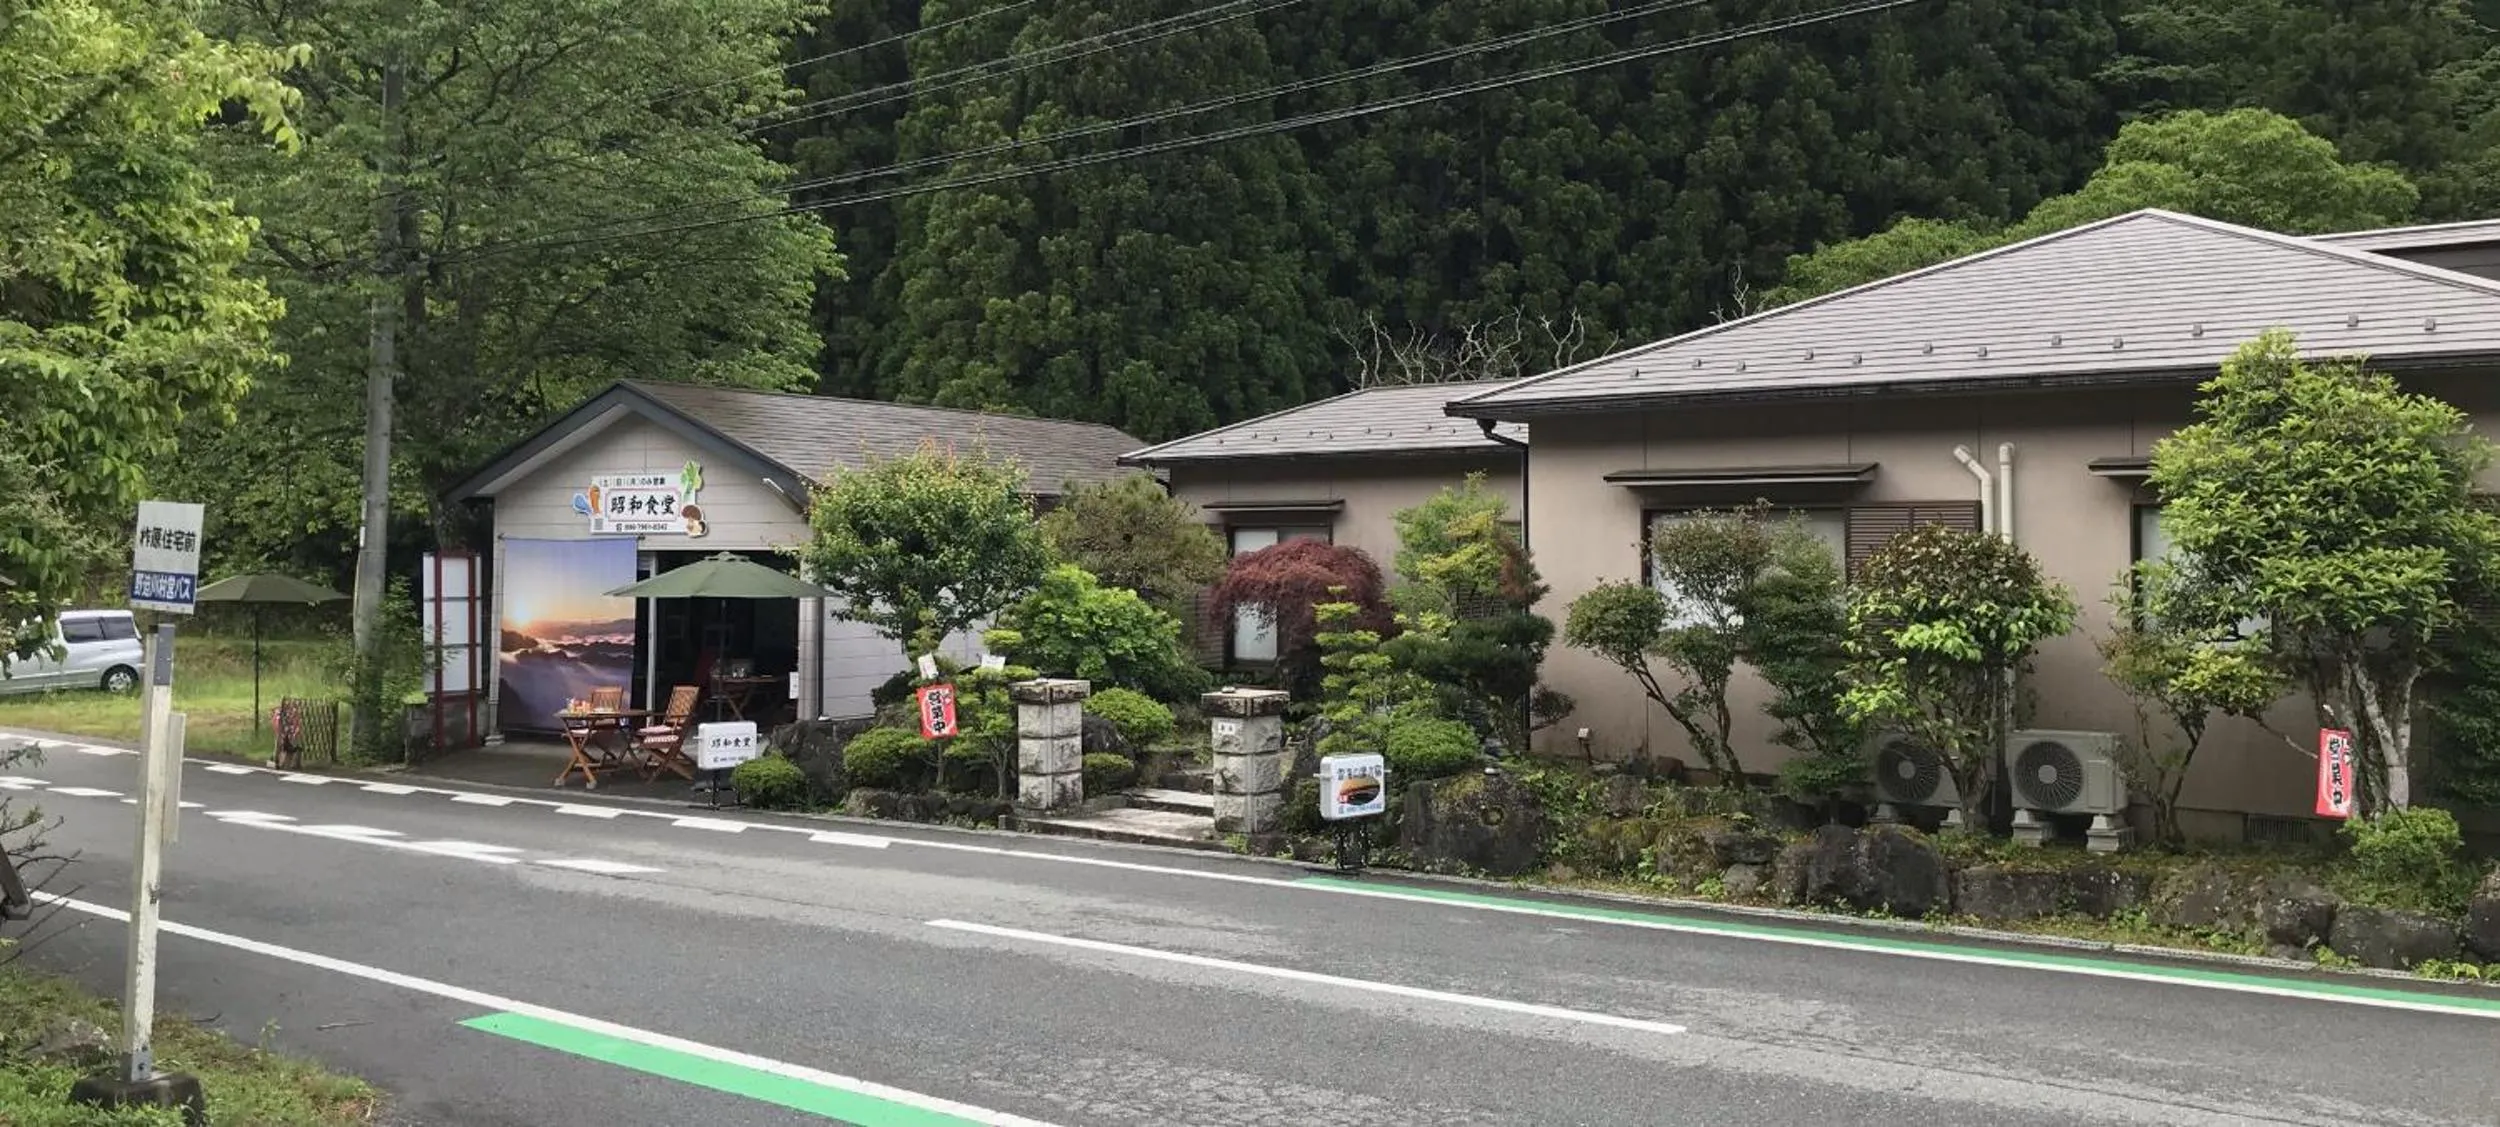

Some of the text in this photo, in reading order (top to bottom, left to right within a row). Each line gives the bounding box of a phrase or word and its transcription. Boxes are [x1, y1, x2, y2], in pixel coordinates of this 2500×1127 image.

[610, 495, 675, 516] 昭和食堂
[134, 573, 192, 600] 野迫川村営バス
[928, 690, 946, 732] 営業中
[711, 737, 751, 747] 昭和食堂
